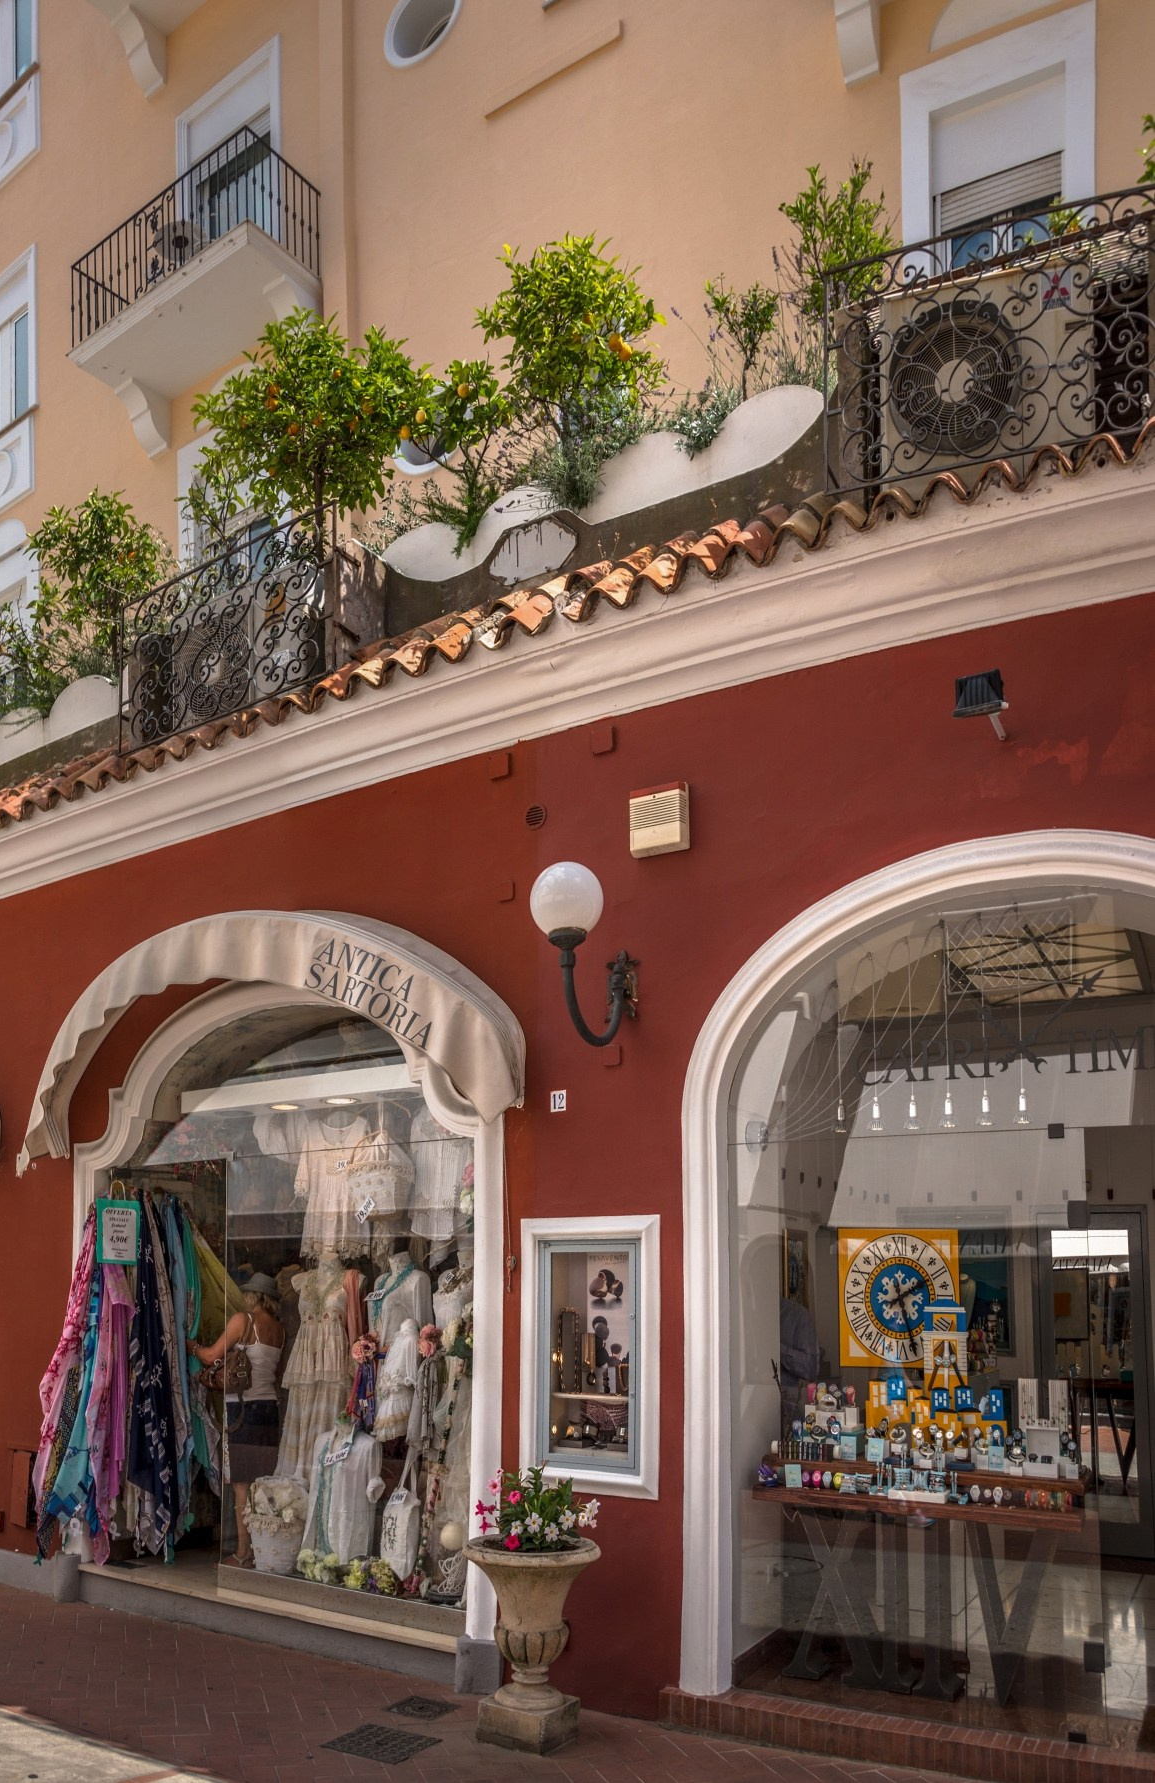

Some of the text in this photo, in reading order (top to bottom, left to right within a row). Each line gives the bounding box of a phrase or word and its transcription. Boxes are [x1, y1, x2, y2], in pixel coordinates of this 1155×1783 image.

[314, 938, 414, 1003] ANTICA
[304, 963, 432, 1050] SARTORIA
[852, 1035, 995, 1087] CAPRI
[552, 1093, 565, 1110] 12
[109, 1235, 129, 1244] 4,90€
